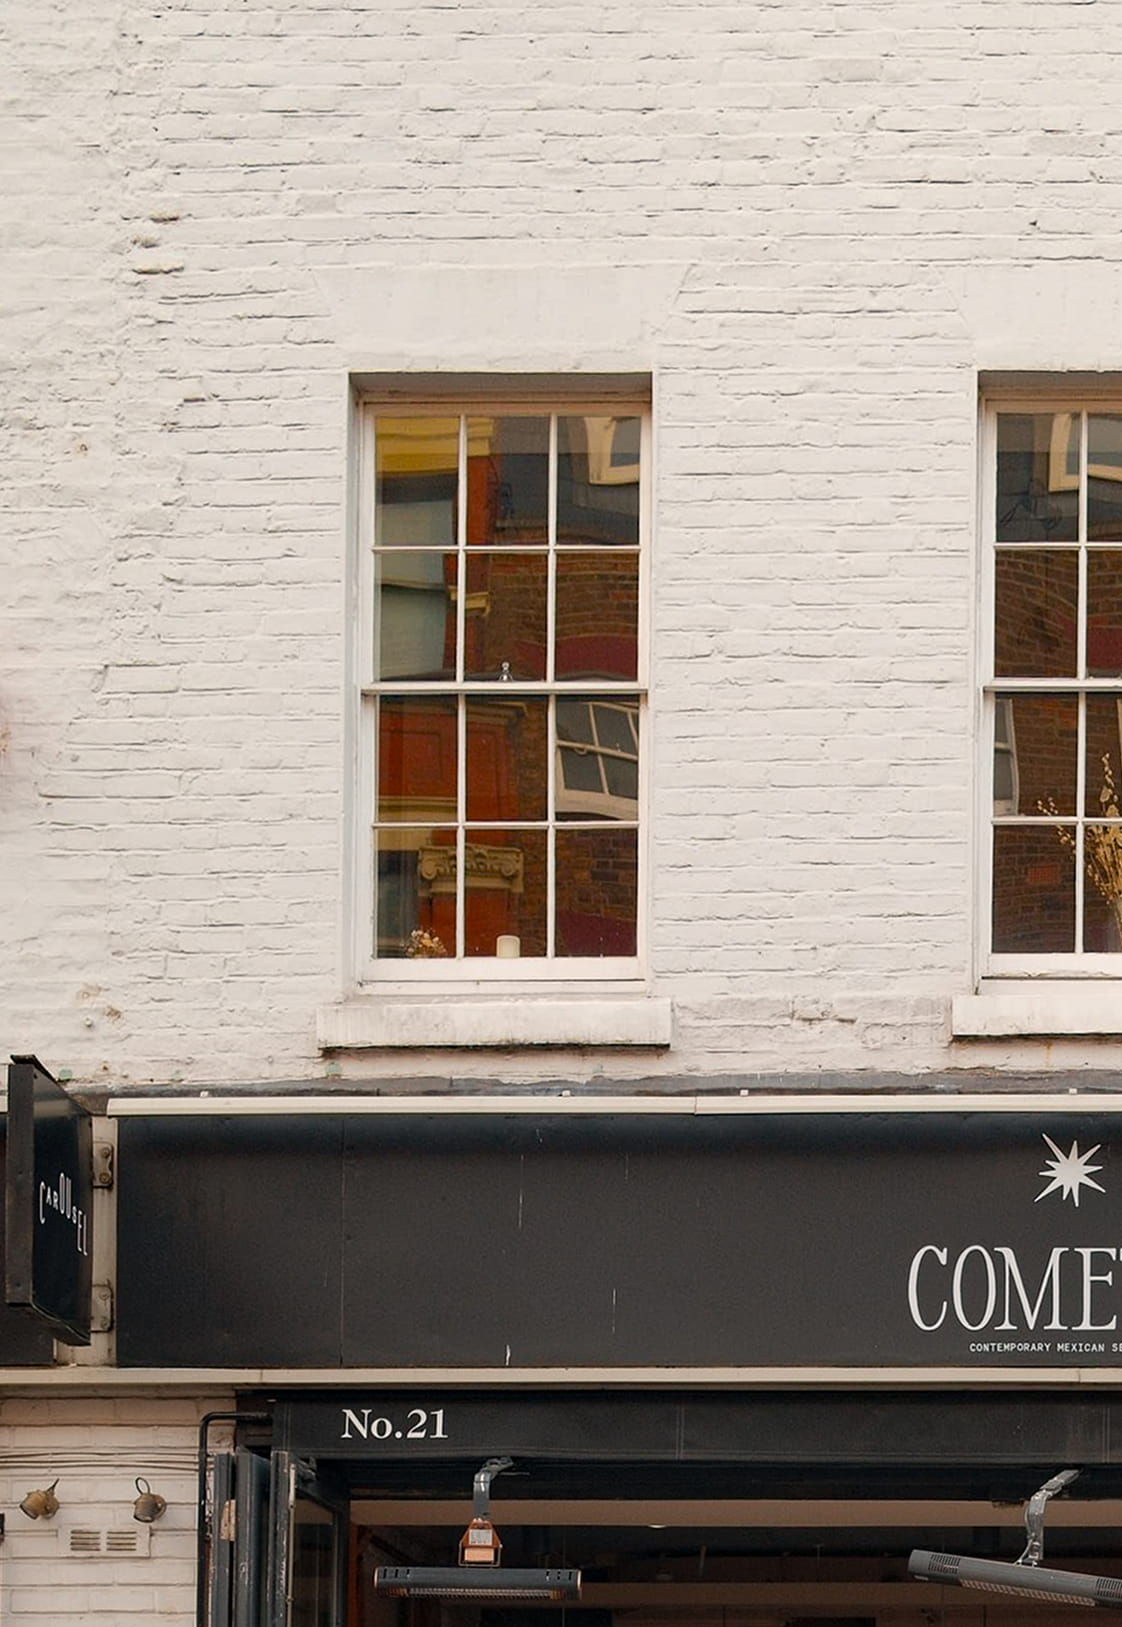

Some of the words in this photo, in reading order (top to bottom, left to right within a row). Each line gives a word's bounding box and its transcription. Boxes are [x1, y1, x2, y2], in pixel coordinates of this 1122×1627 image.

[39, 1172, 88, 1256] CAROUSEL
[969, 1342, 1051, 1353] CONTEMPORARY
[1056, 1342, 1106, 1353] MEXICAN
[340, 1408, 449, 1439] No.21
